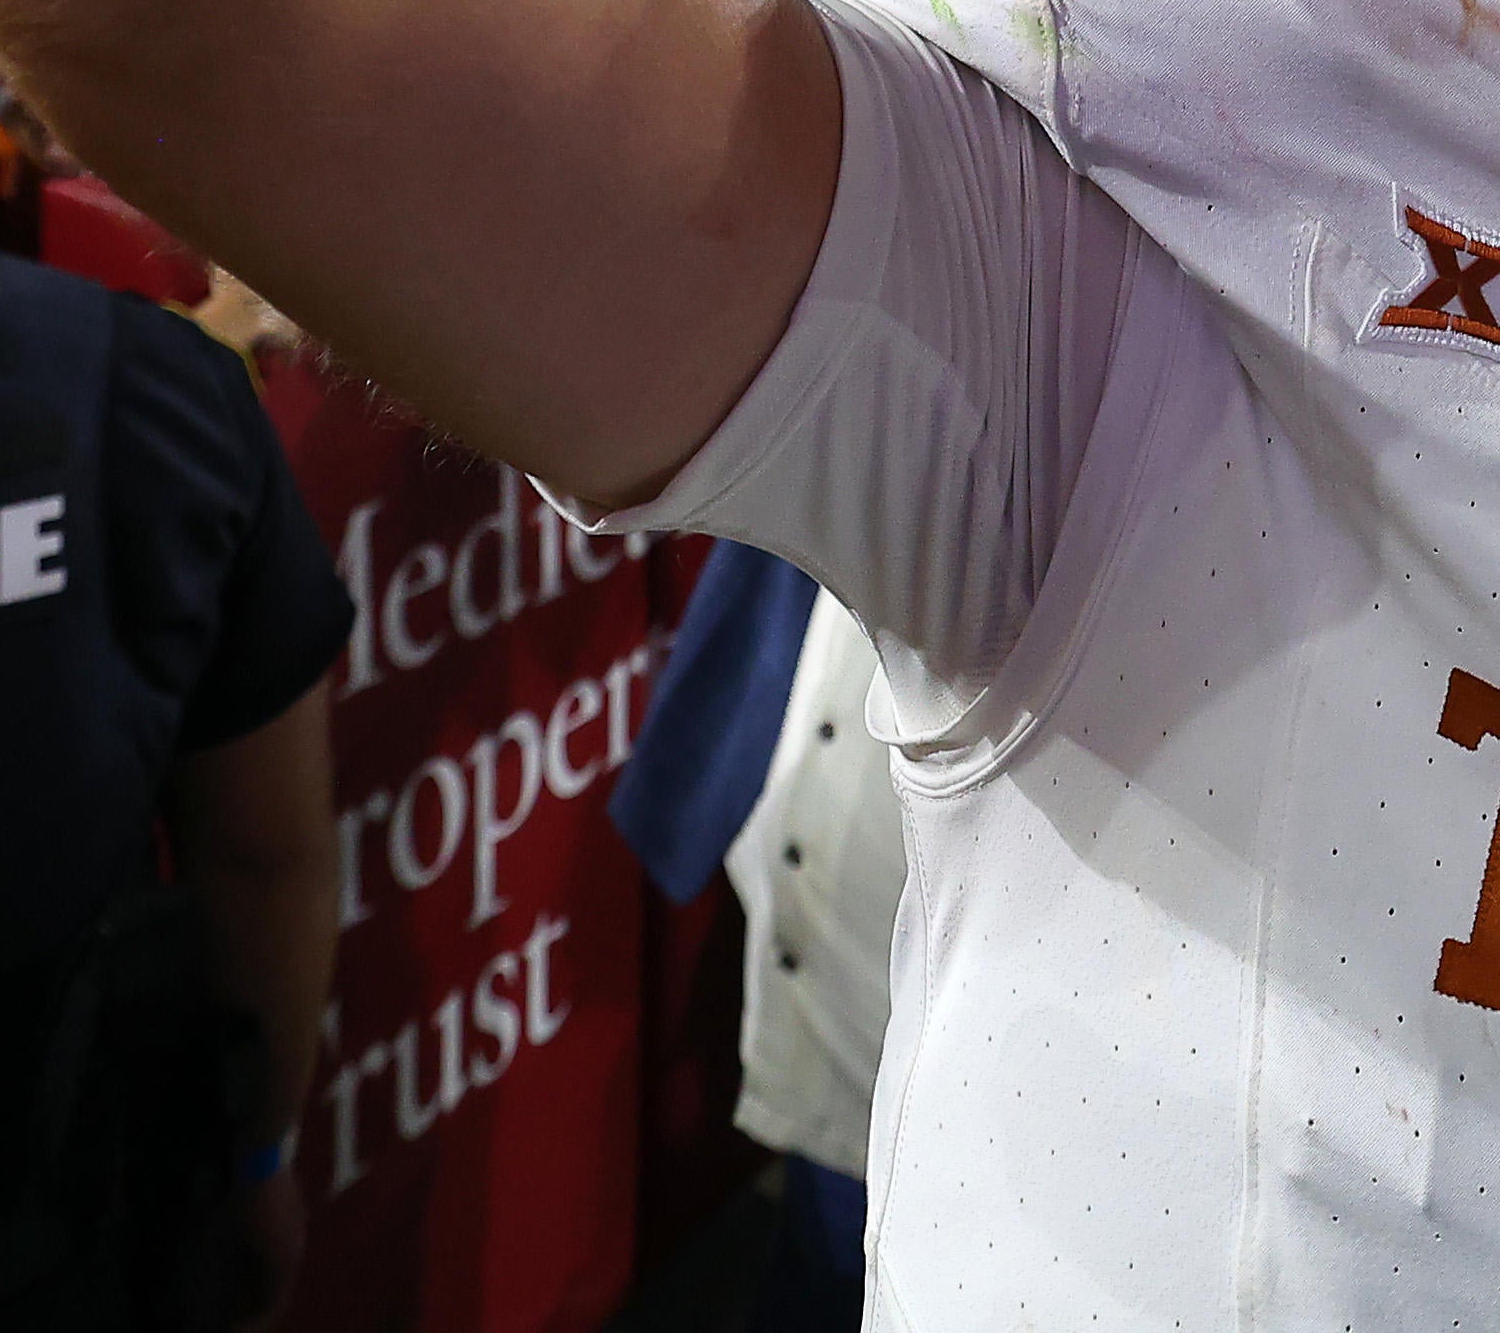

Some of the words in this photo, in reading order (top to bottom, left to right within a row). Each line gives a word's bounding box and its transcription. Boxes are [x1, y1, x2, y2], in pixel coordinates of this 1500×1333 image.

[337, 461, 652, 701] edic
[336, 630, 665, 931] roper
[319, 911, 573, 1199] rust
